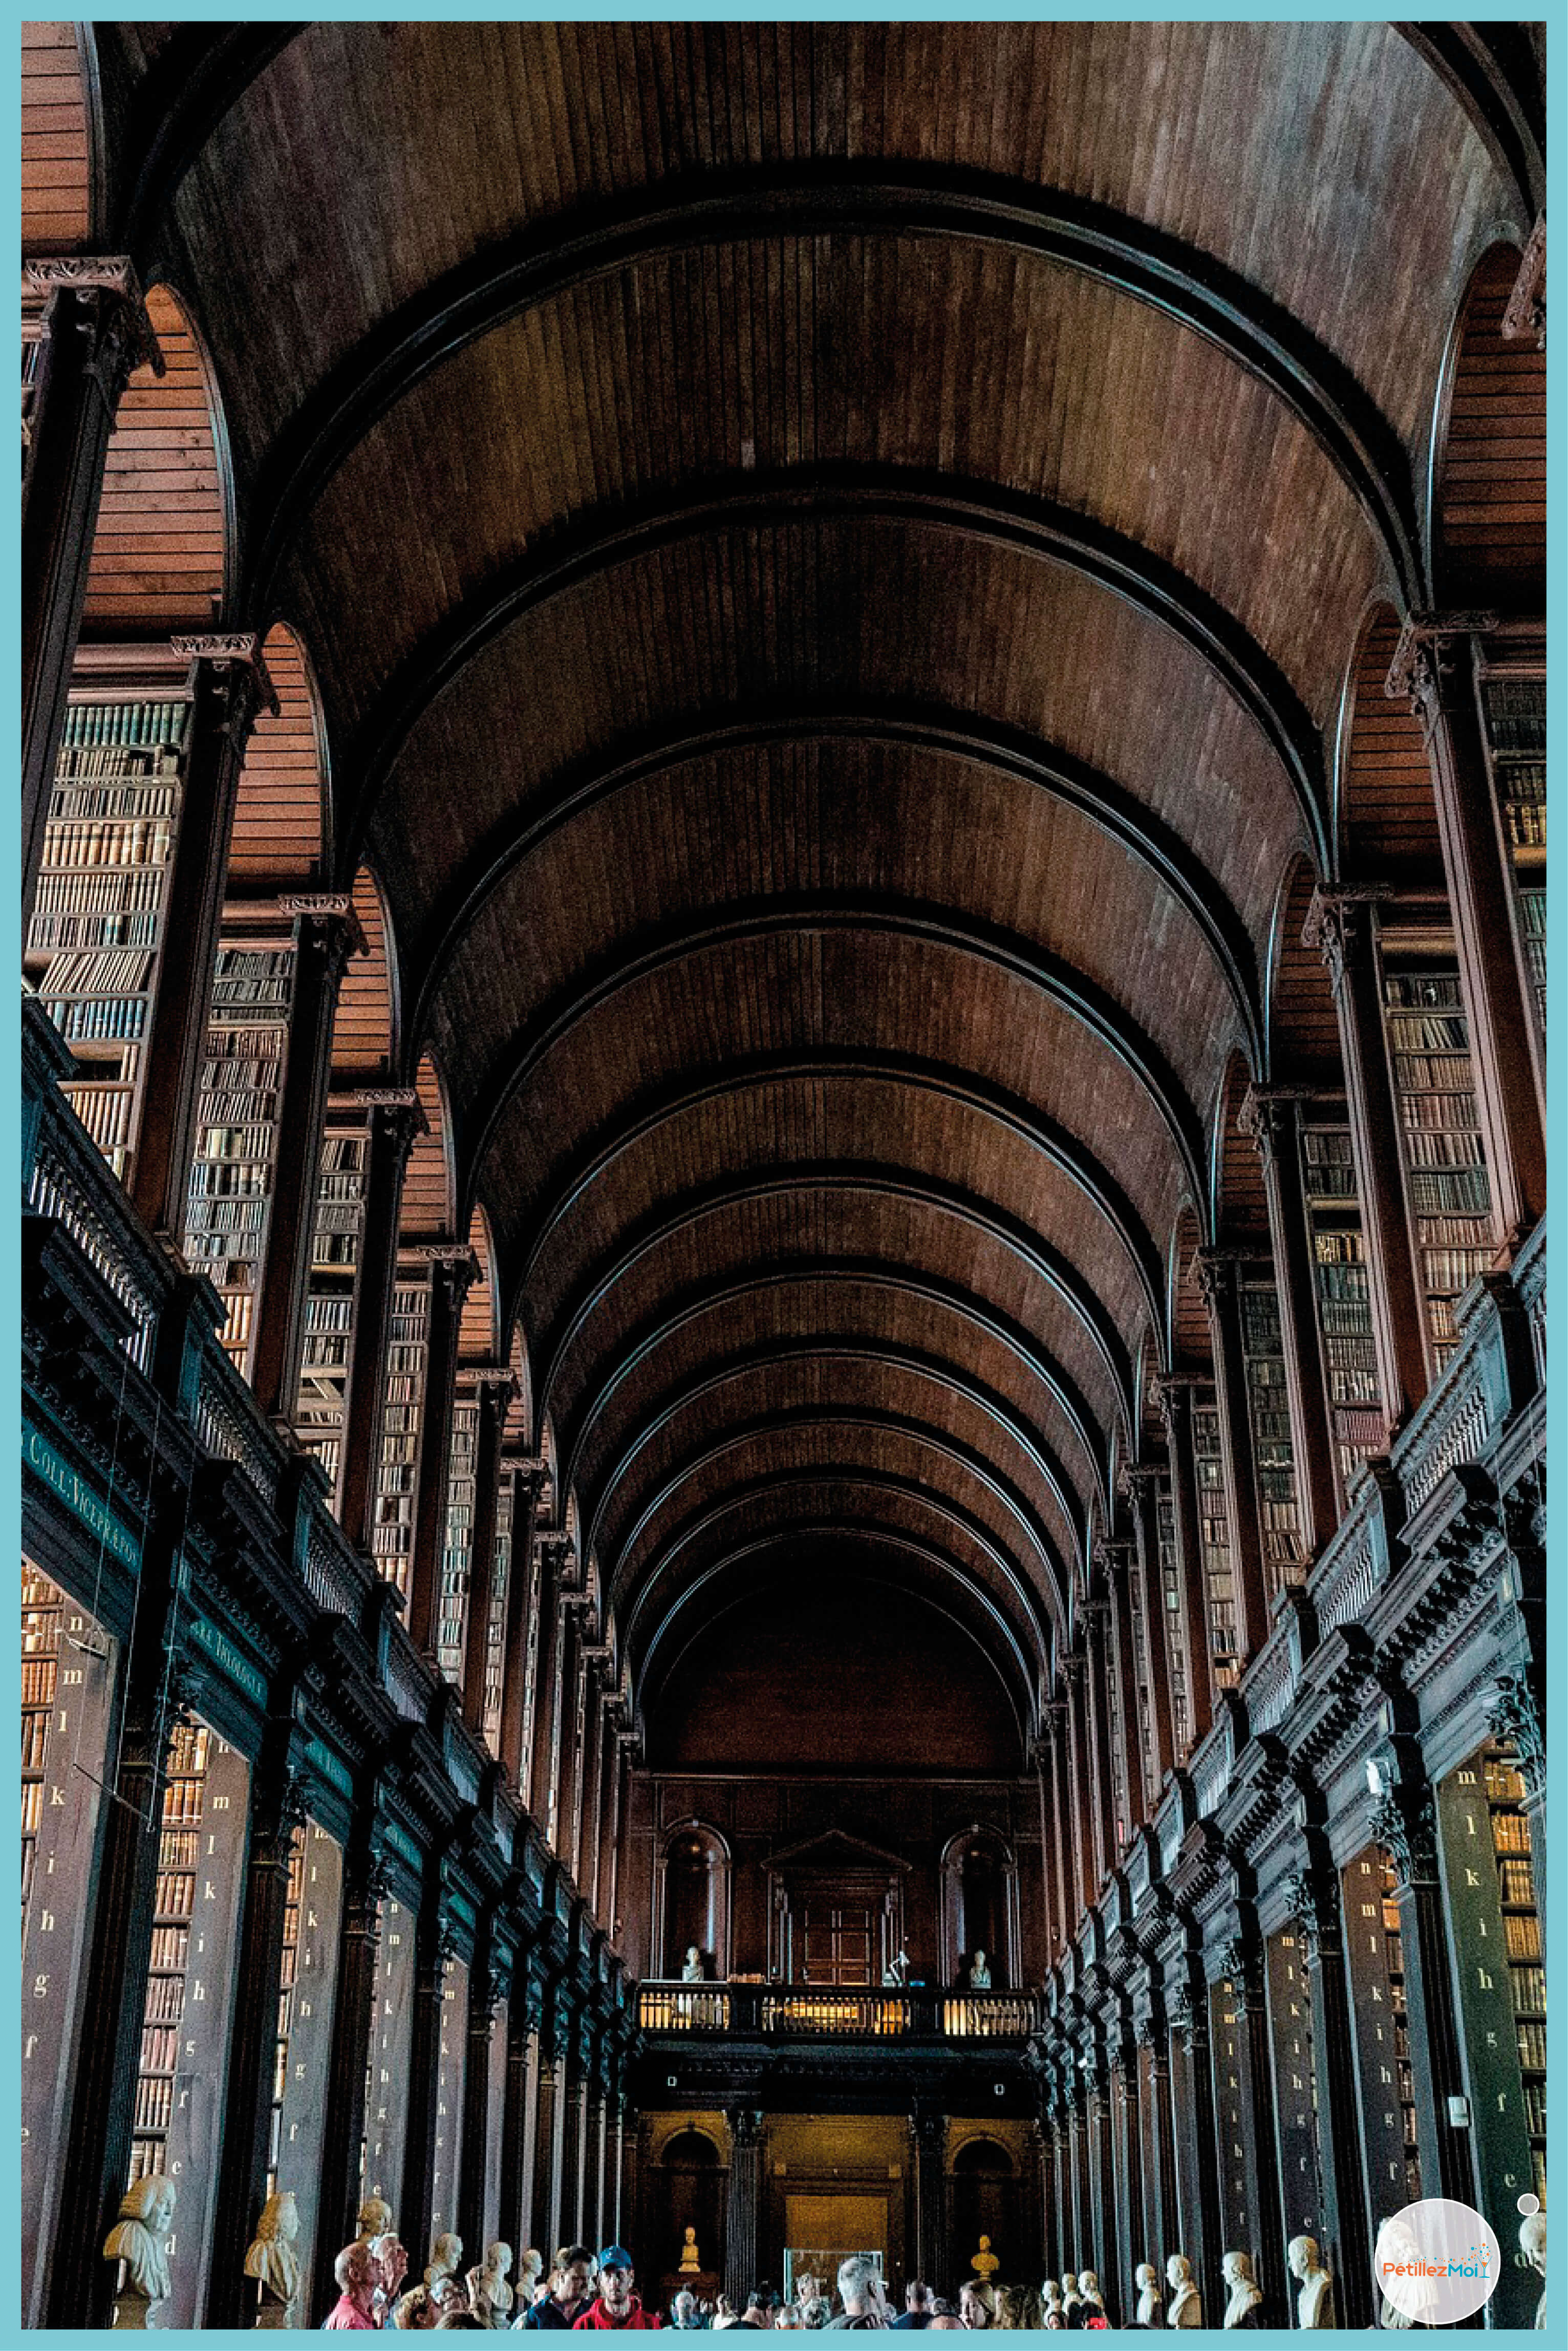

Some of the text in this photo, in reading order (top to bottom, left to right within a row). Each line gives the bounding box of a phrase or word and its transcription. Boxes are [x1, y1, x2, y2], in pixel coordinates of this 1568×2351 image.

[69, 1617, 82, 1631] n
[62, 1670, 82, 1684] m
[59, 1711, 66, 1731] l
[1458, 1771, 1476, 1784] m
[50, 1786, 65, 1805] k
[213, 1797, 229, 1809] m
[1467, 1815, 1475, 1834] l
[207, 1835, 214, 1854] l
[48, 1851, 54, 1873] i
[1361, 1863, 1370, 1874] n
[1465, 1869, 1479, 1885] k
[205, 1882, 216, 1898] k
[308, 1911, 317, 1926] k
[1362, 1905, 1376, 1916] m
[41, 1910, 54, 1930] h
[1480, 1918, 1486, 1935] i
[1370, 1936, 1376, 1953] l
[34, 1975, 50, 1997] g
[1478, 1968, 1493, 1989] h
[192, 1980, 204, 2000] h
[1372, 1986, 1381, 2001] k
[301, 2001, 310, 2016] h
[1377, 2024, 1383, 2040] i
[1487, 2033, 1497, 2047] g
[295, 2064, 306, 2080] g
[1381, 2066, 1391, 2083] h
[1498, 2093, 1506, 2111] f
[172, 2161, 181, 2174] e
[1505, 2174, 1516, 2187] e
[165, 2236, 176, 2255] d
